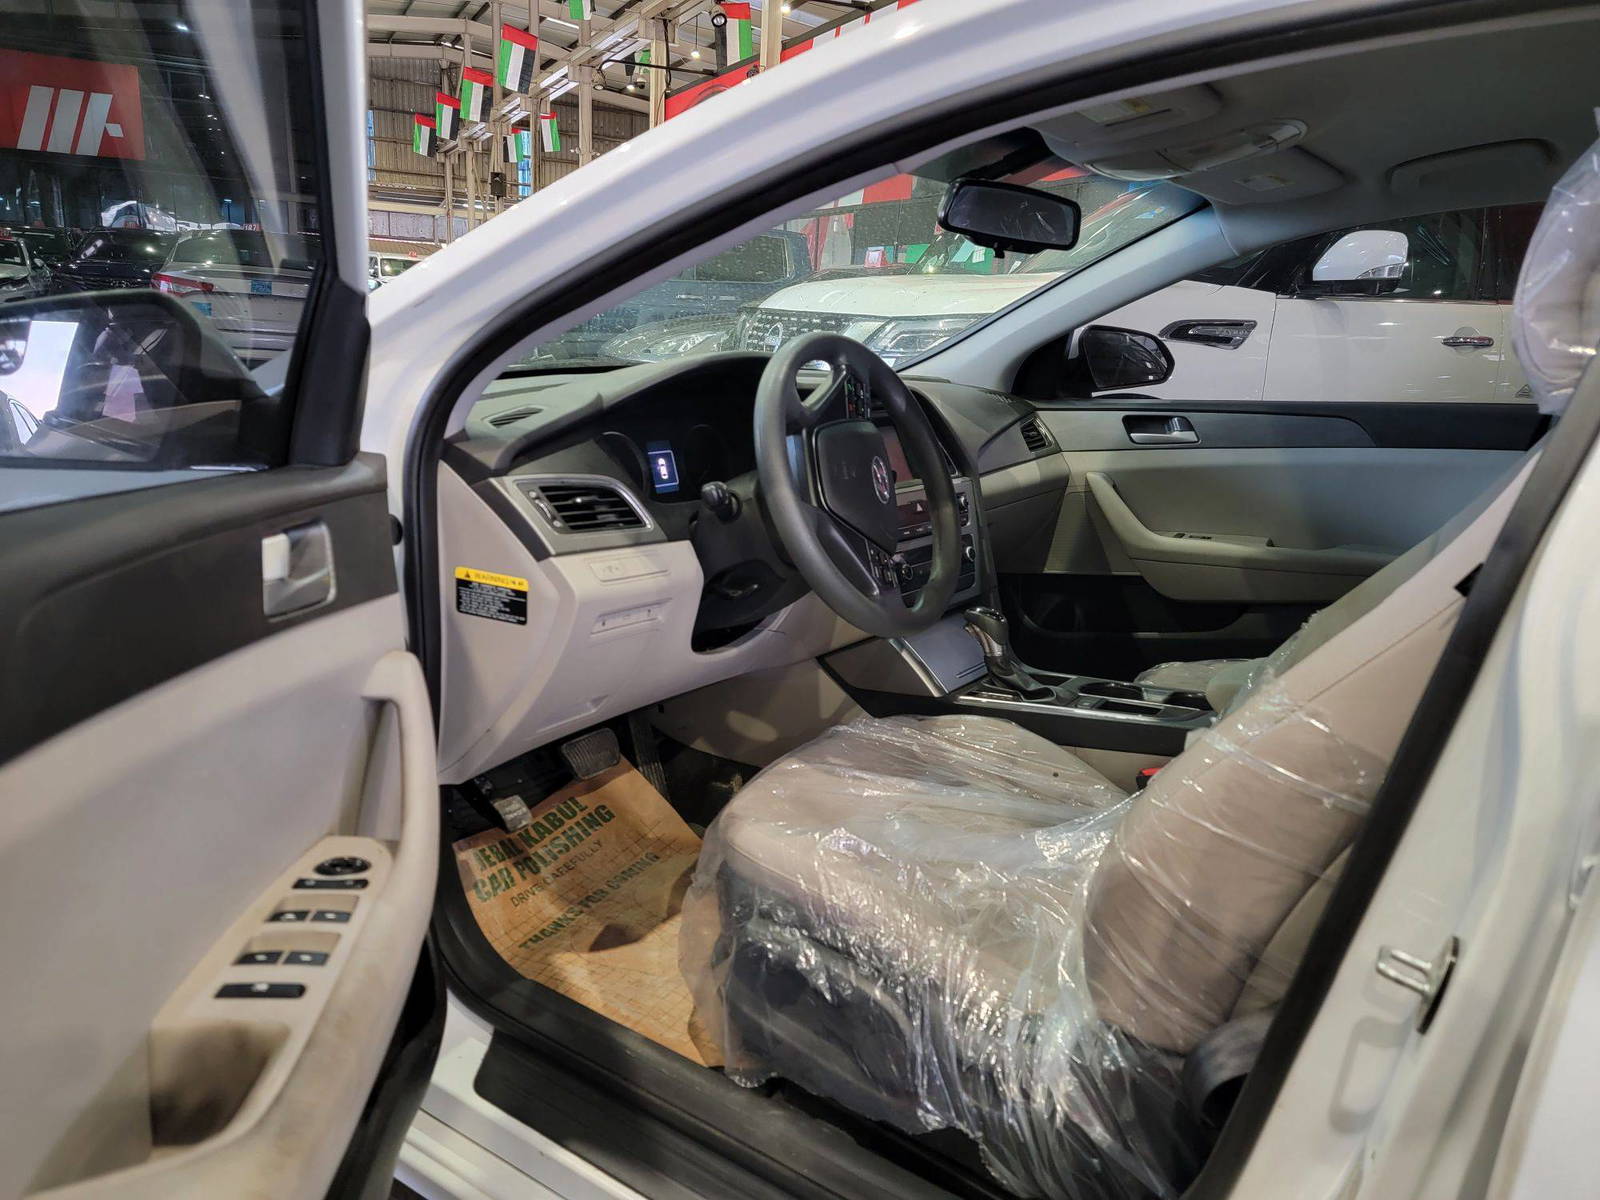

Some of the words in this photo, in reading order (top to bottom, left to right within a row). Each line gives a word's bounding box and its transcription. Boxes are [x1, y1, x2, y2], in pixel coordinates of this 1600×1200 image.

[473, 867, 516, 902] CAR
[512, 804, 616, 881] POLISHING
[517, 796, 589, 849] KABUL
[510, 880, 544, 908] DRIVE
[544, 839, 603, 886] CAREFULLY
[519, 905, 583, 949] THANKS
[579, 888, 609, 910] FOR
[607, 851, 661, 890] COMING
